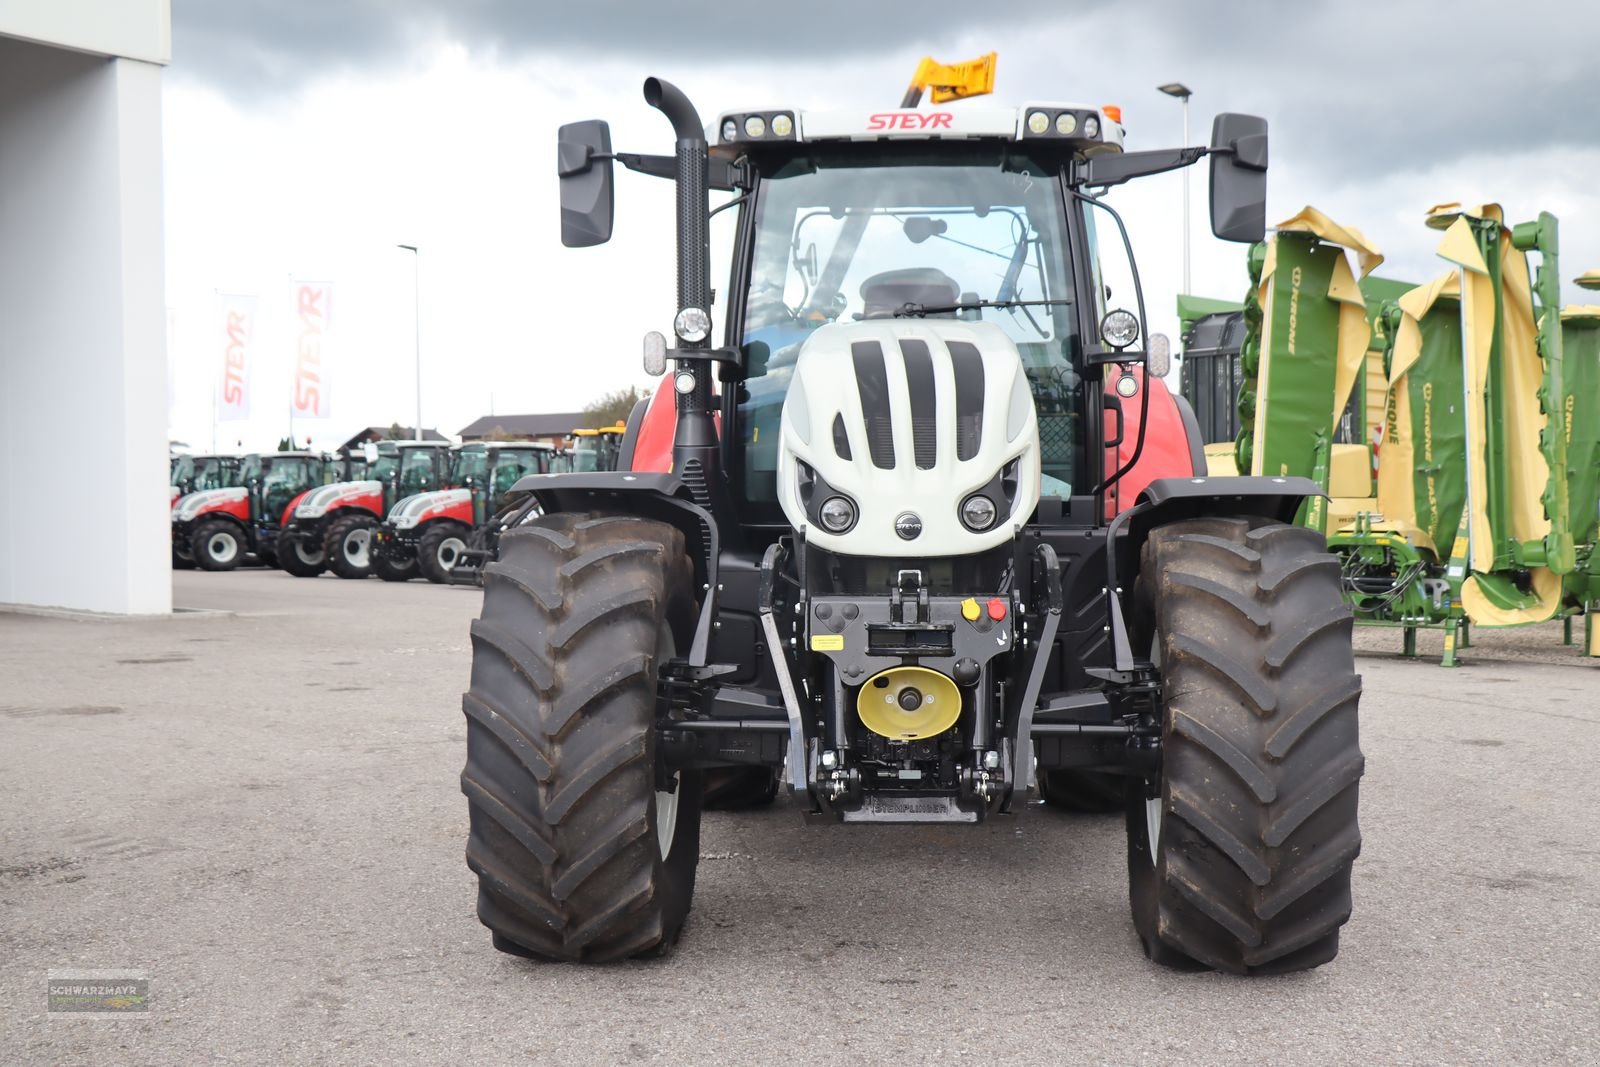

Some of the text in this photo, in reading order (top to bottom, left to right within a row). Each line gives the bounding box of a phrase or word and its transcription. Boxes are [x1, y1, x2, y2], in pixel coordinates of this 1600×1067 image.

[866, 113, 953, 130] STEYR
[225, 310, 245, 406] STEYR
[296, 286, 322, 416] STEYR
[874, 803, 949, 814] STEMPLINGER
